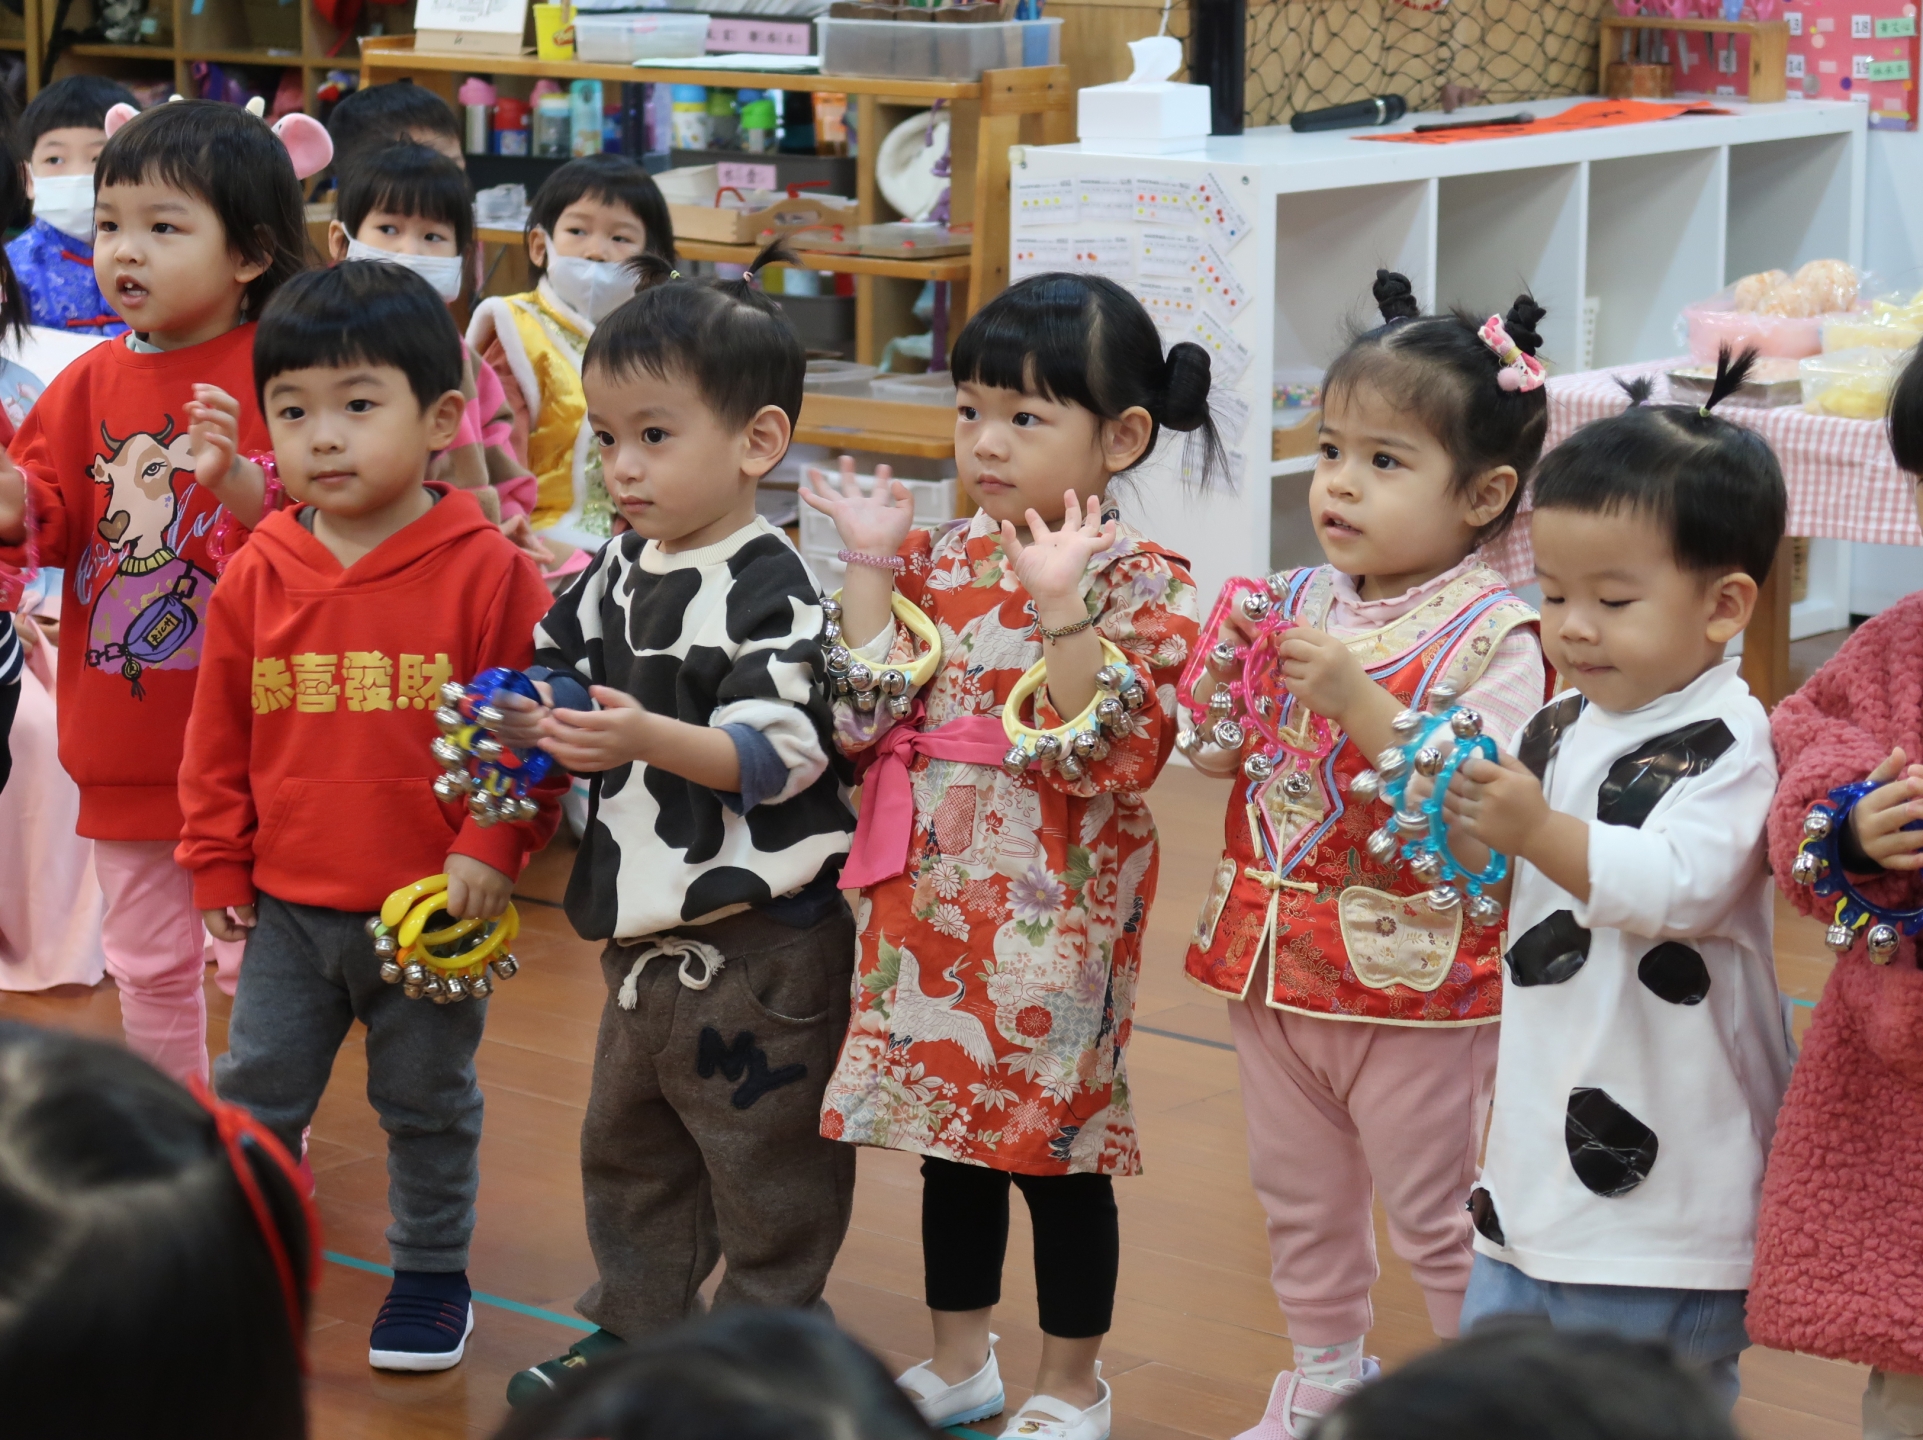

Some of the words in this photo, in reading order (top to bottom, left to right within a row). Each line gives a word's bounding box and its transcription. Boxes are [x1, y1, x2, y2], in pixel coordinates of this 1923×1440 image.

[1855, 20, 1869, 34] 18
[1789, 60, 1802, 73] 14
[1856, 61, 1870, 75] 19
[251, 650, 453, 715] 恭喜發財
